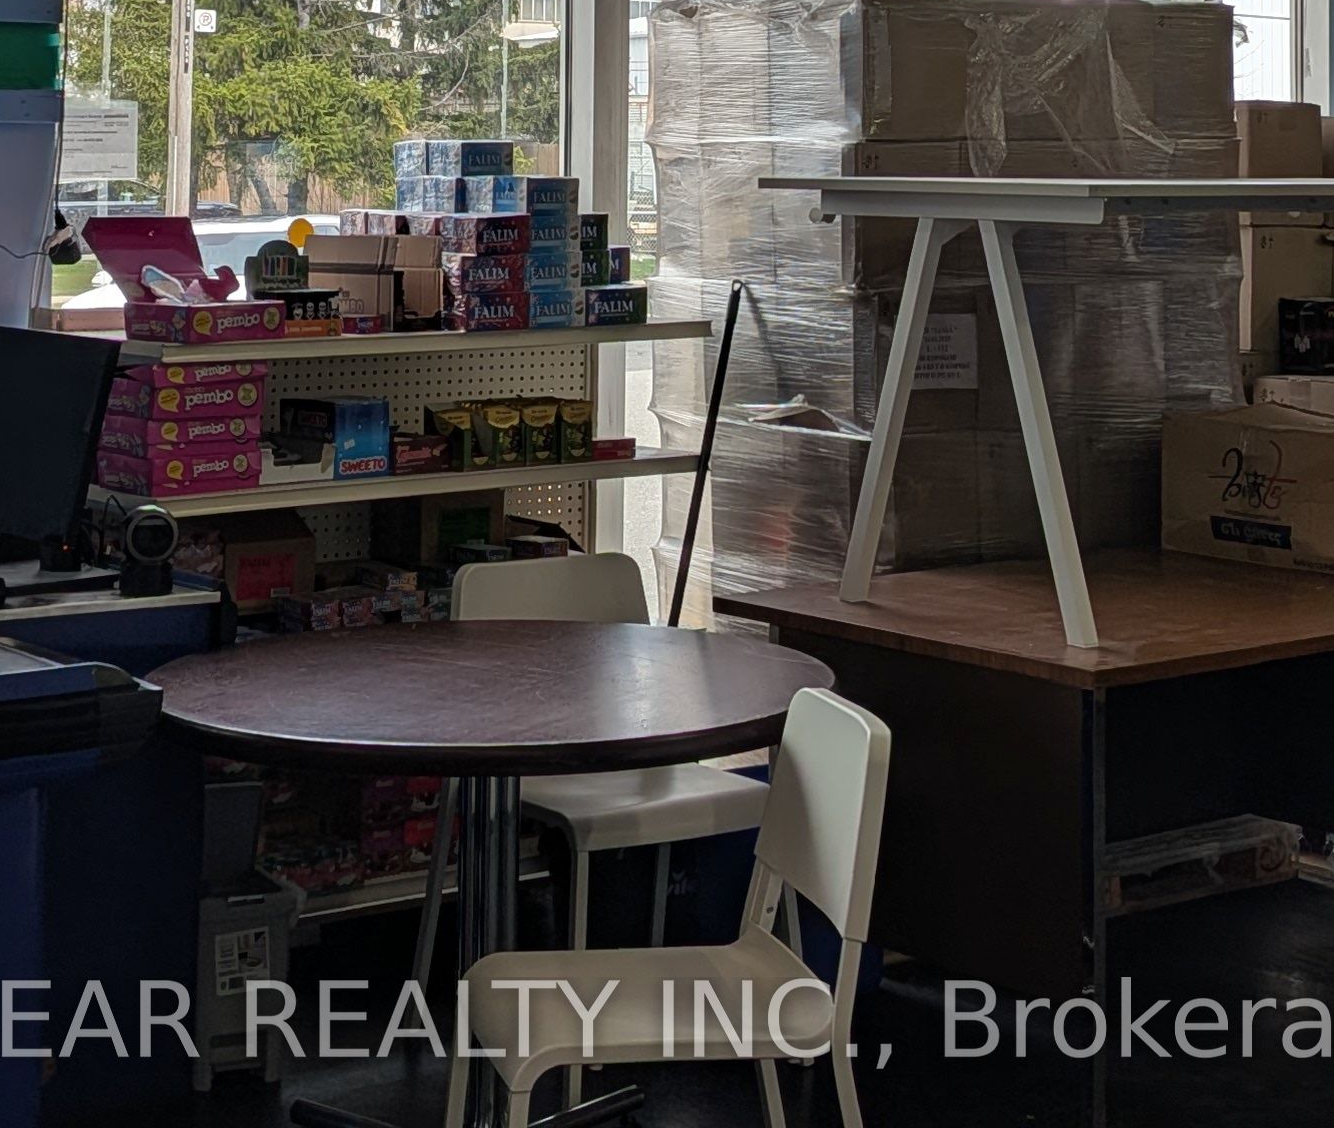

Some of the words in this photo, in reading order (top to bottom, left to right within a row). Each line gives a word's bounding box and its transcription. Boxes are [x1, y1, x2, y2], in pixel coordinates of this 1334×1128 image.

[482, 228, 519, 243] FALIM
[531, 227, 566, 240] FALIM
[468, 267, 510, 282] FALIM
[531, 266, 566, 280] FALIM
[474, 305, 515, 320] FALIM
[536, 302, 571, 316] FALIM
[594, 300, 634, 314] FALIM
[217, 312, 261, 334] pembo
[194, 363, 233, 383] pembo
[185, 388, 235, 412] pembo
[188, 422, 226, 440] pembo
[193, 459, 230, 479] pembo
[340, 457, 387, 473] SWEETO
